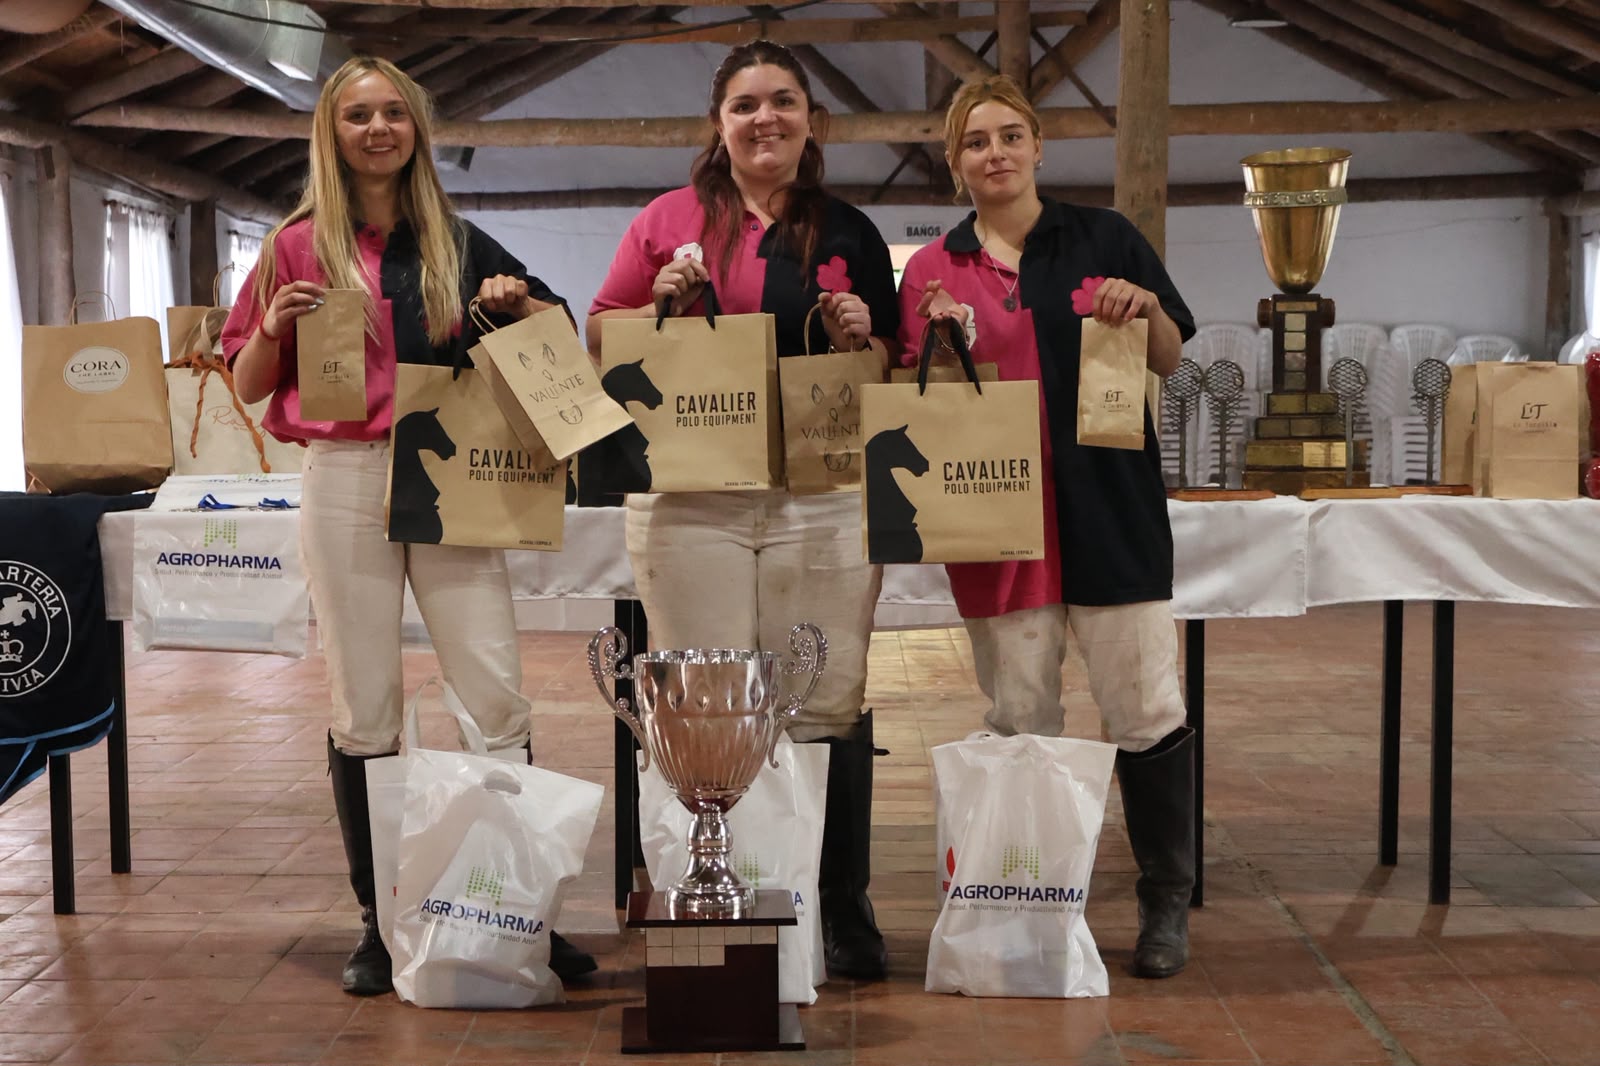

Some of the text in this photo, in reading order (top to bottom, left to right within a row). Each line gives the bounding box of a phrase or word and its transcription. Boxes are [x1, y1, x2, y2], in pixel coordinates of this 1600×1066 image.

[906, 224, 941, 237] BAÑOS
[70, 360, 121, 373] CORA
[529, 374, 584, 402] VALIENTE
[676, 392, 756, 414] CAVALIER
[676, 412, 756, 427] POLO EQUIPMENT
[801, 423, 860, 440] VALIENT
[469, 449, 560, 470] CAVALI
[469, 469, 556, 484] POLO EQUIPMENT
[943, 459, 1030, 481] CAVALIER
[944, 480, 1031, 494] POLO EQUIPMENT
[157, 552, 282, 570] AGROPHARMA
[950, 885, 1083, 903] AGROPHARMA
[421, 898, 543, 935] AGROPHARMA
